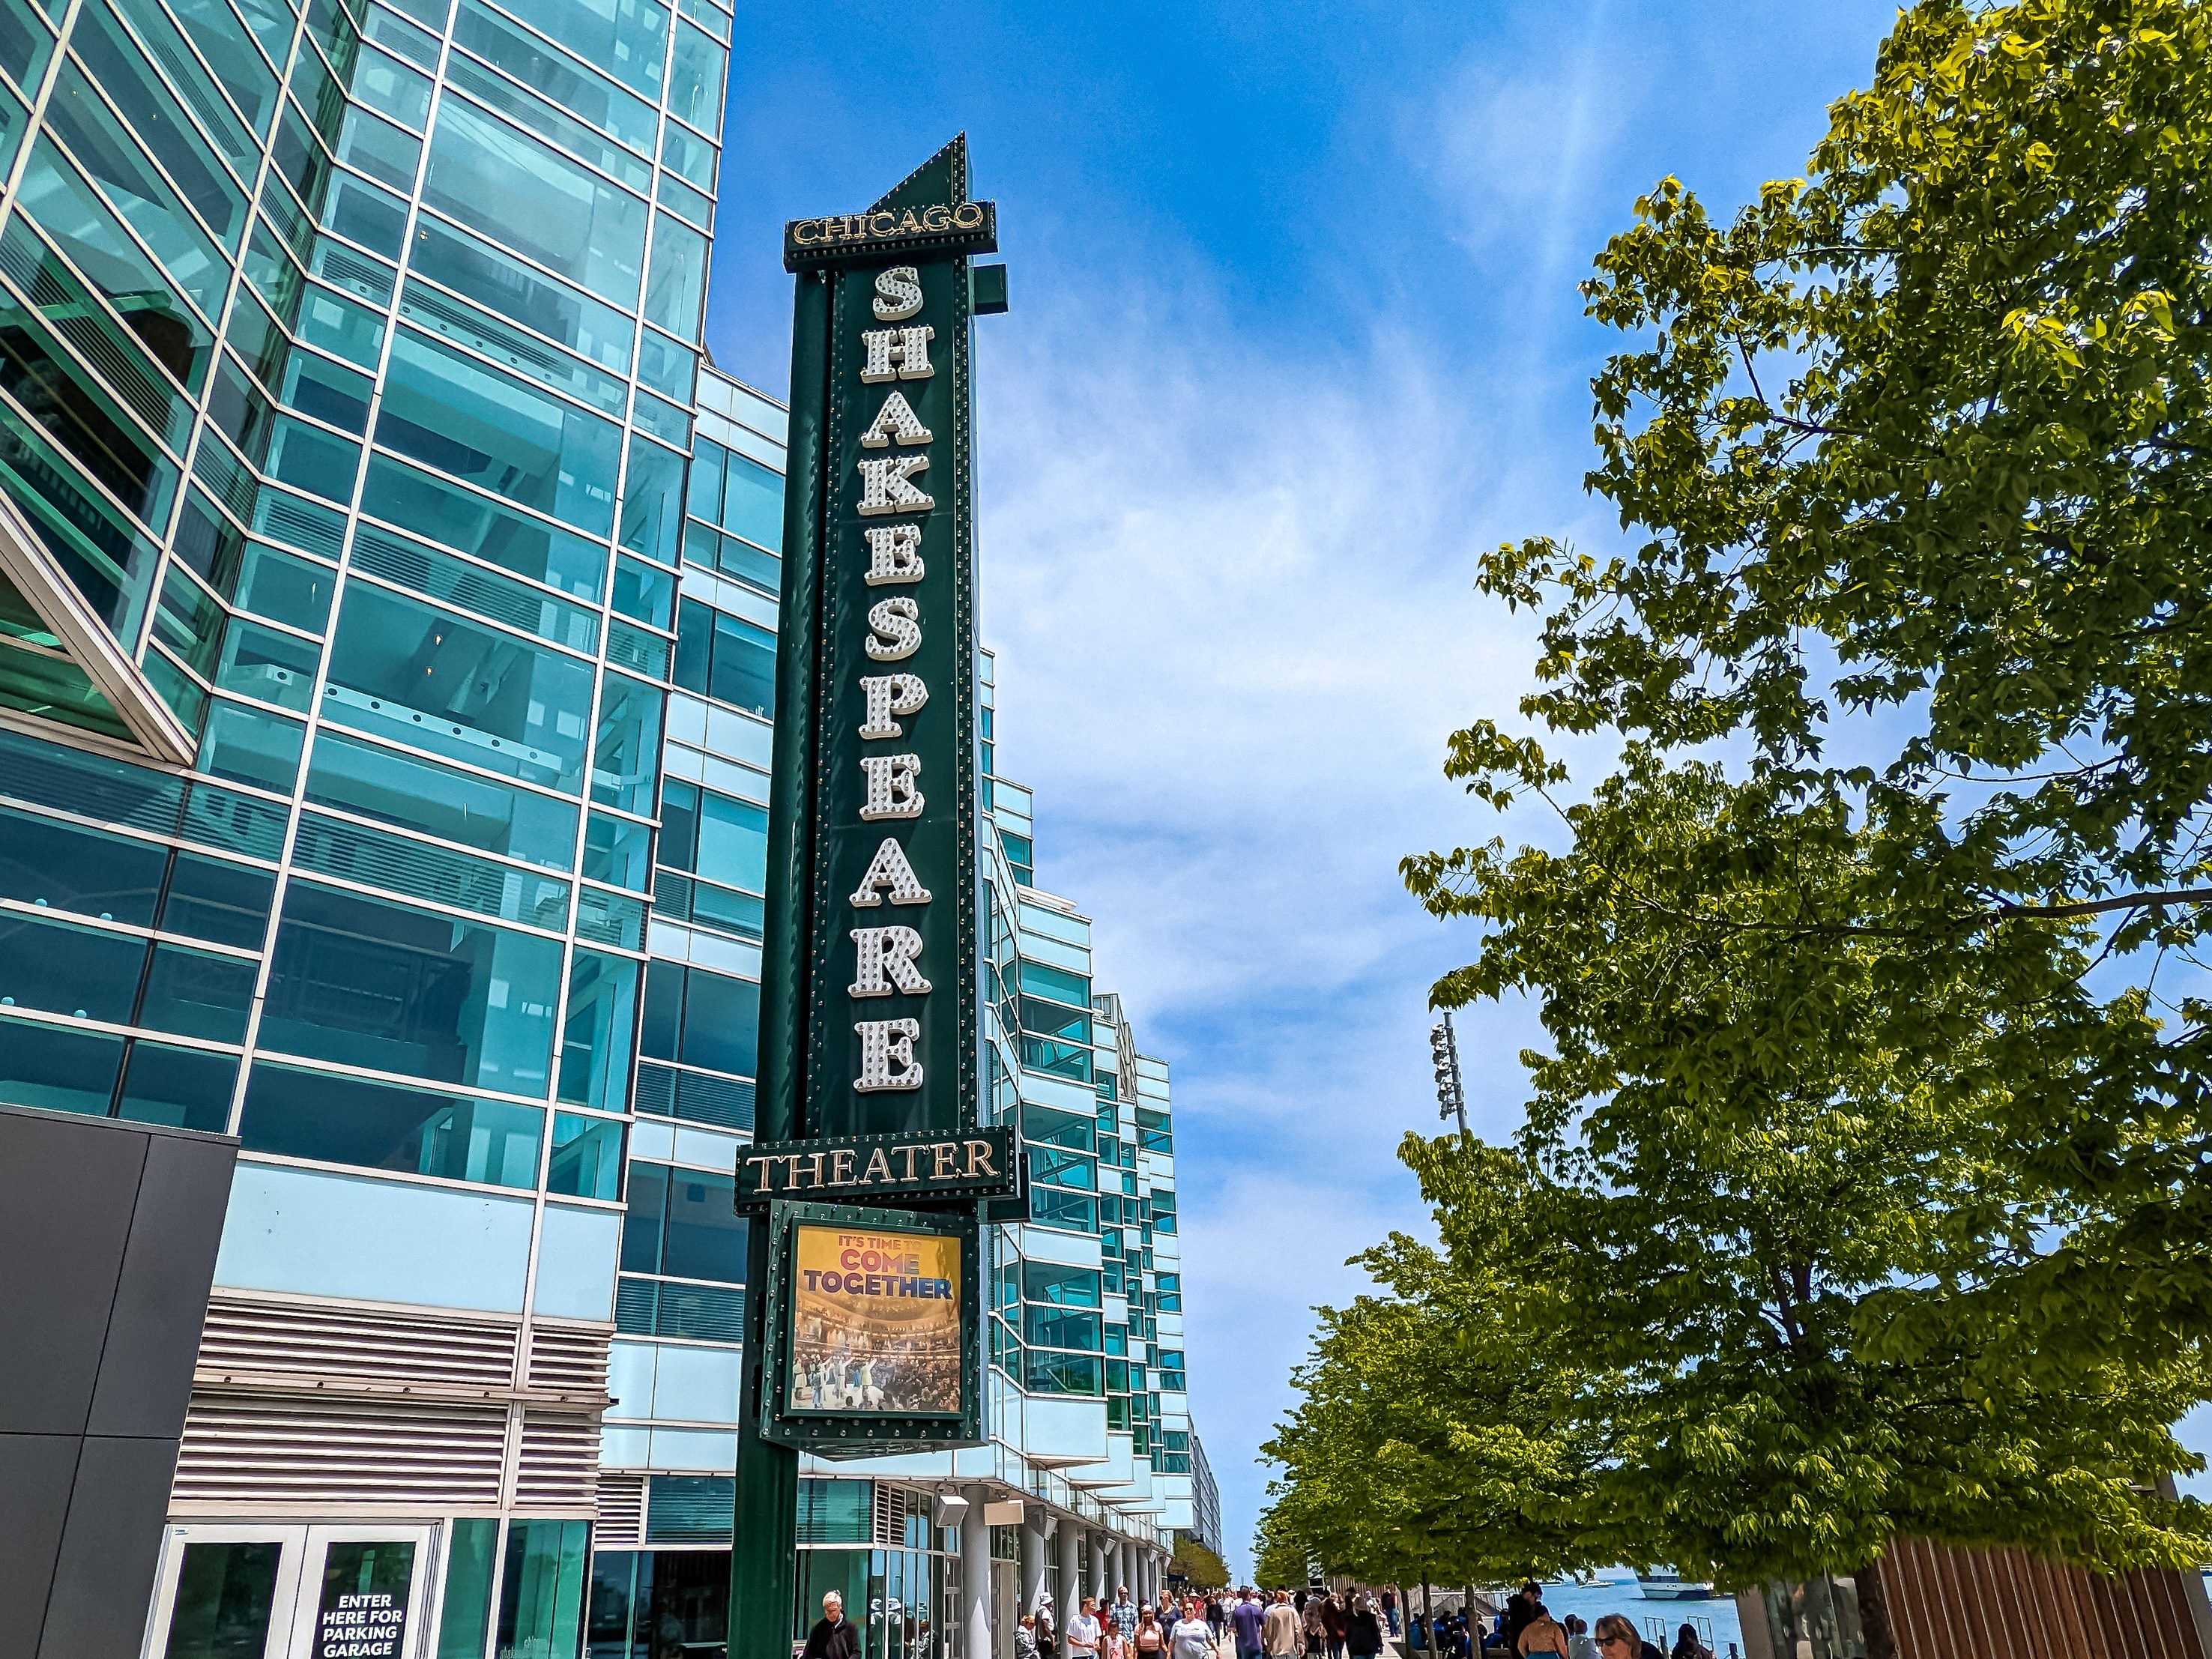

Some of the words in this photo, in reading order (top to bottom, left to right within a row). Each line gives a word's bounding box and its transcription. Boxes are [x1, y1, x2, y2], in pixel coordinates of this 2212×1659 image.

[793, 202, 985, 245] CHICAGO
[847, 266, 935, 1093] SHAKESPEARE
[746, 1140, 1002, 1194] THEATER
[838, 1235, 864, 1248] IT'S
[867, 1237, 901, 1249] TIME
[840, 1248, 919, 1274] COME
[803, 1269, 953, 1300] TOGETHER
[338, 1594, 392, 1609] ENTER
[322, 1610, 367, 1625] HERE
[369, 1610, 403, 1624] FOR
[322, 1625, 397, 1642] PARKING
[323, 1642, 393, 1658] GARAGE
